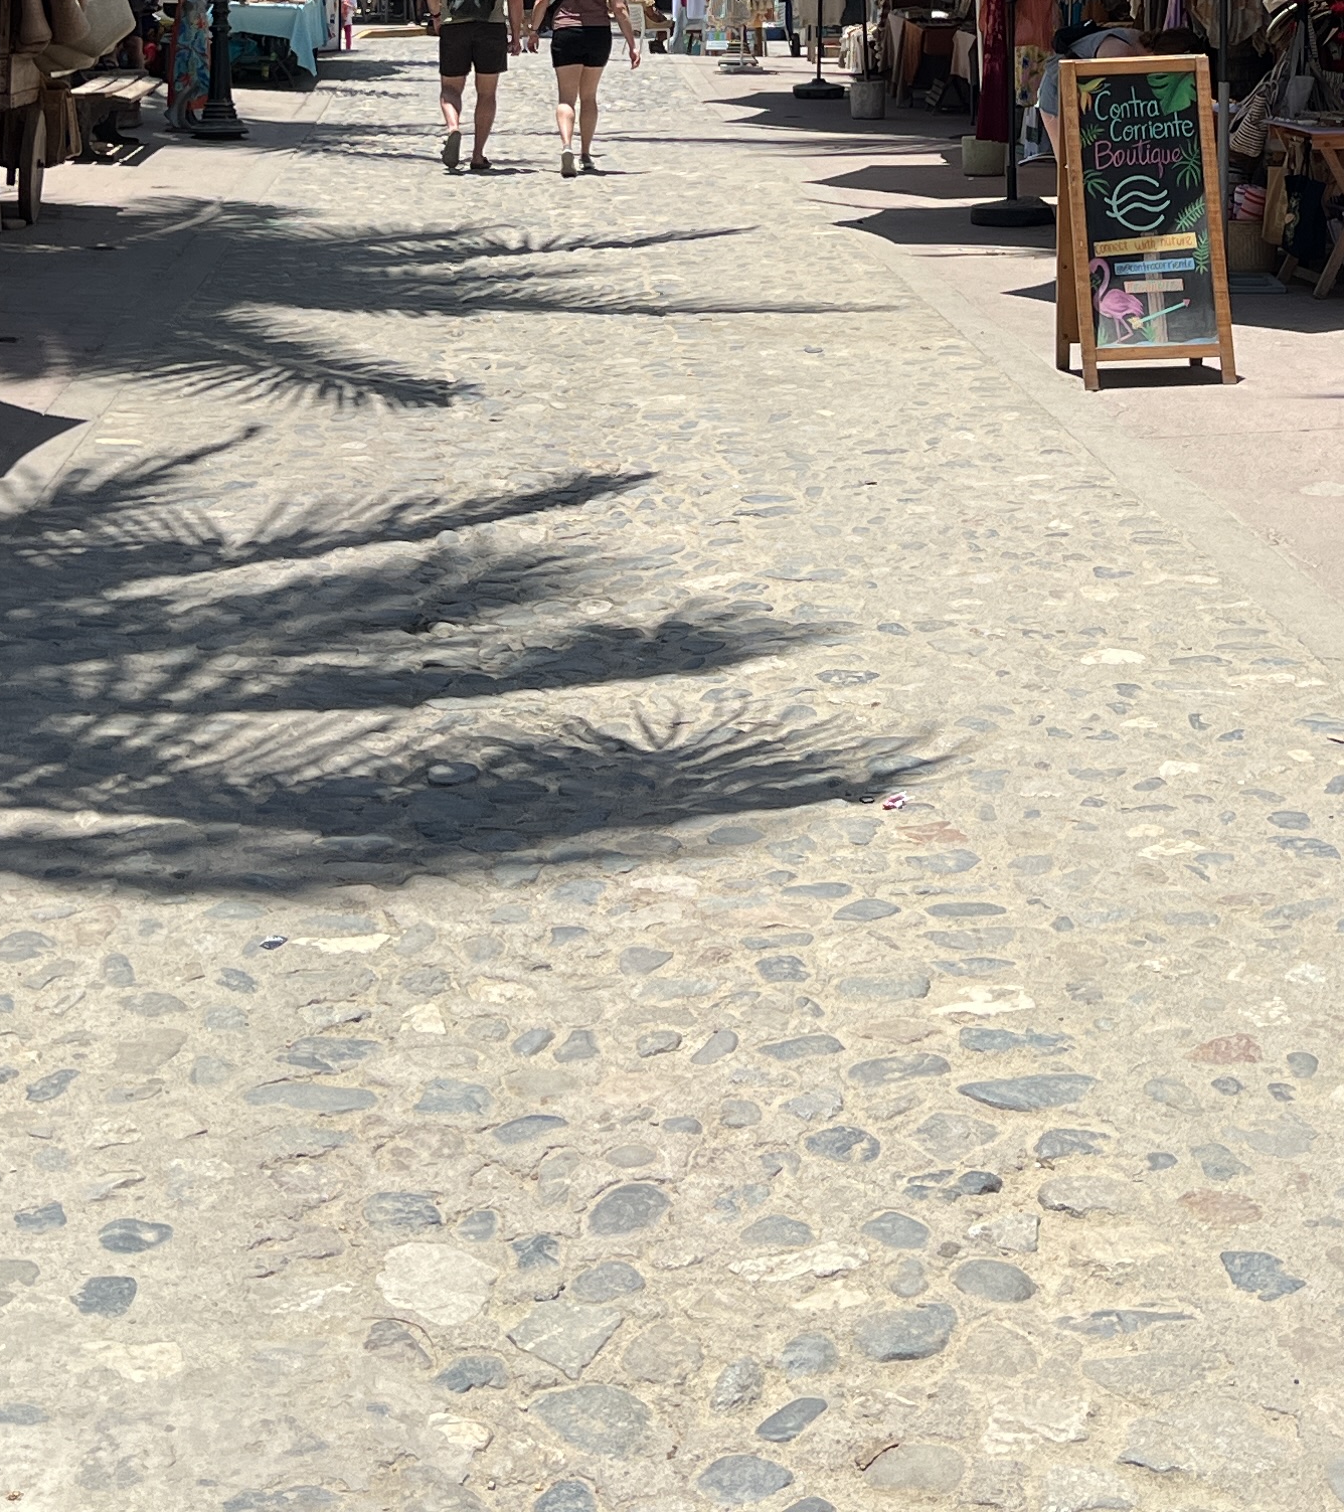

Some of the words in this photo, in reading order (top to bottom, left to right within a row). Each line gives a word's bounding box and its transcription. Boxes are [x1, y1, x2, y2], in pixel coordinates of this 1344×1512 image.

[1094, 85, 1160, 121] Contra
[1109, 111, 1195, 142] Corriente
[1094, 139, 1184, 179] Boutique
